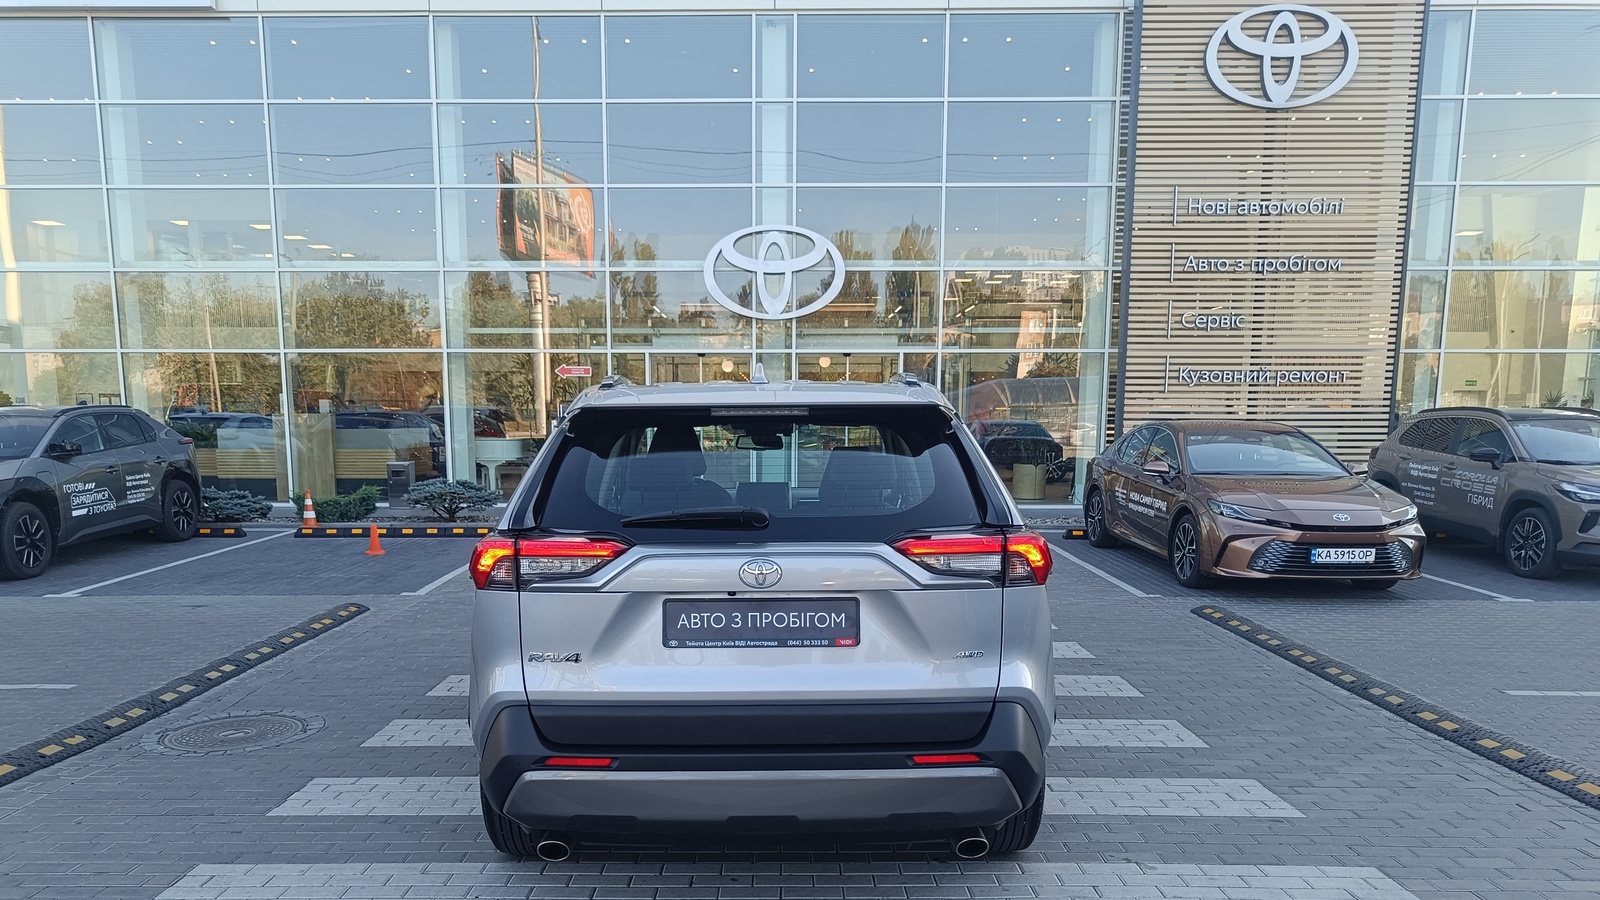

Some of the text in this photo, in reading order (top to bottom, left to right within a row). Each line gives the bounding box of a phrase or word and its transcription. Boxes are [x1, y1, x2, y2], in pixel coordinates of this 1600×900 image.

[1187, 196, 1345, 215] Нові автомобілі
[1183, 254, 1342, 276] Авто з пробігом
[1181, 311, 1247, 332] Сервіс
[1178, 366, 1350, 386] Кузовний ремонт
[1455, 470, 1500, 485] COROLLA
[63, 482, 85, 493] ГОТОВІ
[1440, 476, 1497, 495] CROSS
[72, 491, 109, 506] ЗАРЯДИТИСЯ
[1317, 550, 1332, 560] KA
[1333, 550, 1357, 560] 5915
[677, 612, 846, 629] АВТО З ПРОБІГОМ
[704, 640, 722, 648] Центр
[787, 639, 802, 647] (044)
[528, 652, 583, 664] RAV4
[953, 650, 985, 659] AWD
